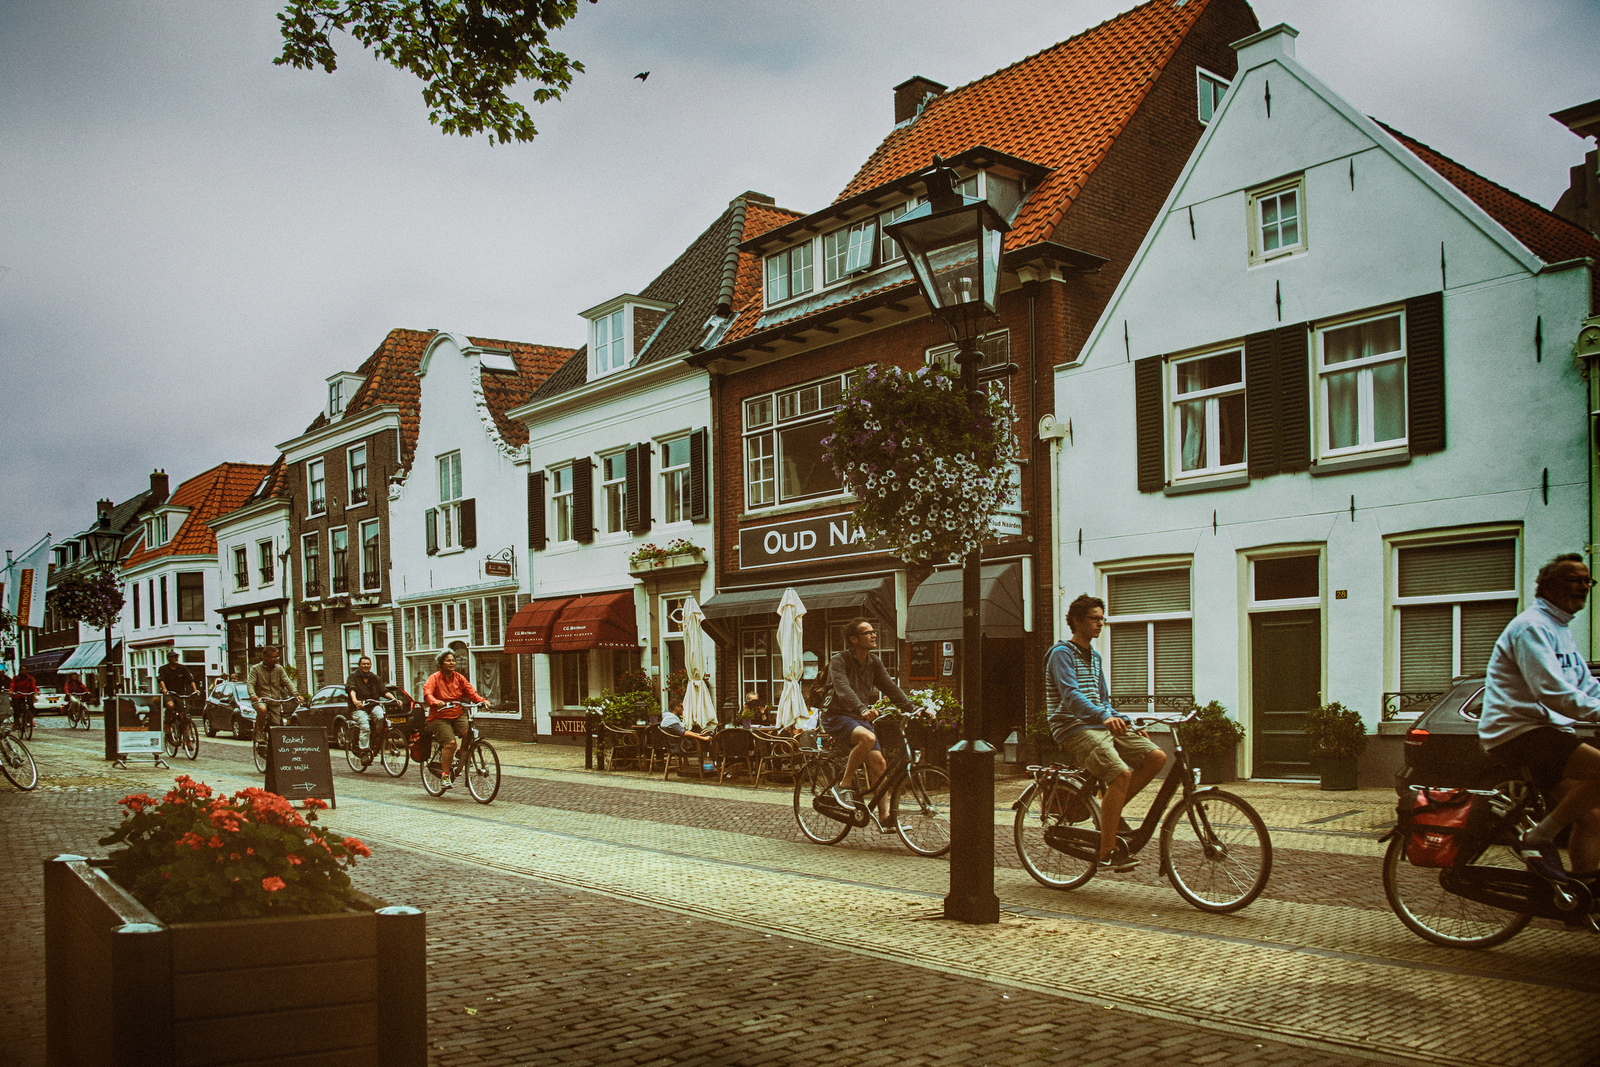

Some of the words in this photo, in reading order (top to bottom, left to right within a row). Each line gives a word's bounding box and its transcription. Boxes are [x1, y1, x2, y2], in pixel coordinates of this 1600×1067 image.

[764, 530, 817, 555] OUD
[829, 520, 867, 547] NA
[1337, 590, 1346, 599] 28
